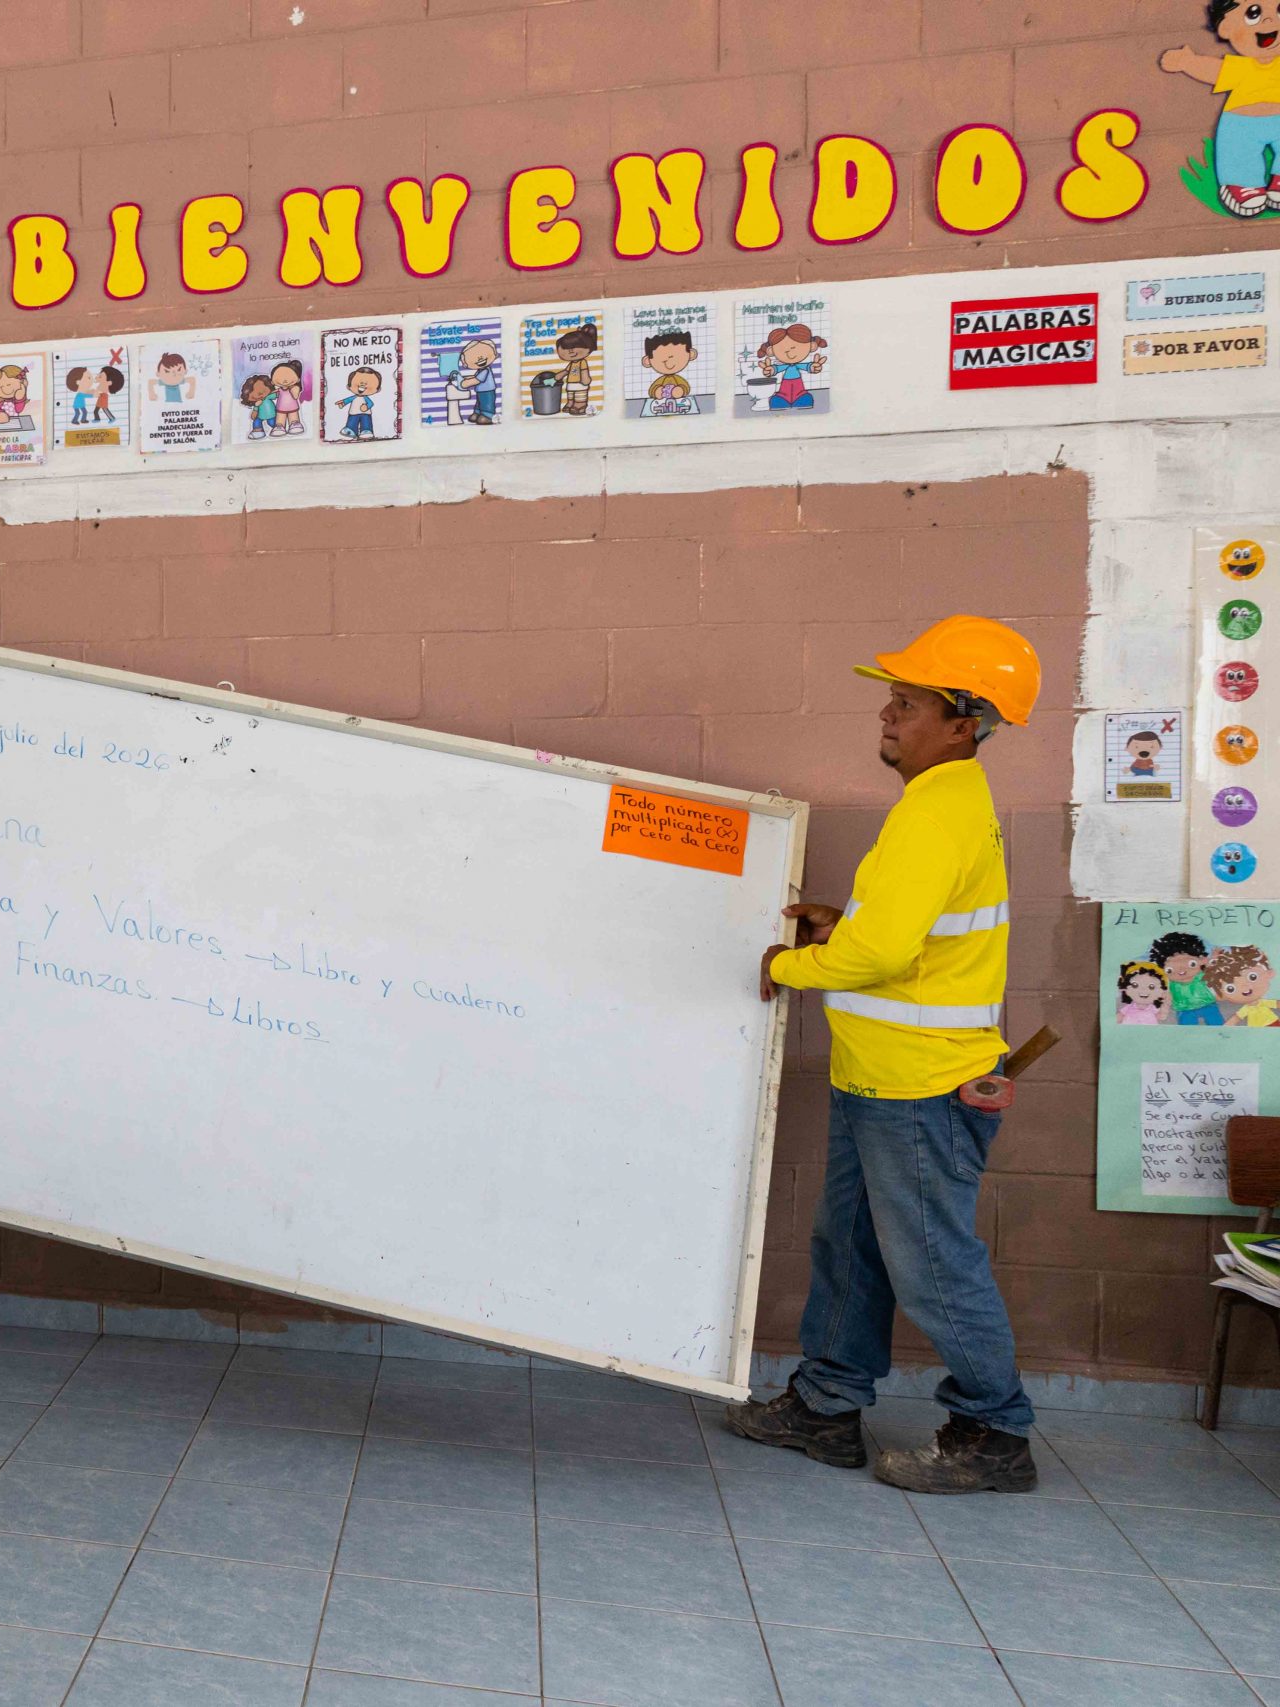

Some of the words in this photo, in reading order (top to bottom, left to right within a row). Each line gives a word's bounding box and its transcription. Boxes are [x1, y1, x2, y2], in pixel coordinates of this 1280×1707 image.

[8, 109, 1148, 310] BIENVENIDOS
[1164, 293, 1223, 307] BUENOS
[1228, 288, 1262, 303] DÍAS
[633, 309, 656, 318] Lava
[658, 307, 673, 317] tus
[675, 306, 705, 315] manos
[784, 302, 794, 312] el
[797, 300, 824, 311] baño
[524, 319, 543, 328] Tira
[546, 317, 554, 327] el
[557, 315, 581, 328] papel
[674, 315, 685, 324] de
[687, 315, 695, 323] ir
[697, 313, 707, 322] al
[768, 314, 797, 326] limpio
[955, 308, 1092, 334] PALABRAS
[428, 324, 463, 337] Lávate
[467, 323, 481, 334] las
[524, 329, 533, 338] el
[536, 328, 556, 337] bote
[240, 341, 268, 351] Ayudo
[279, 338, 300, 348] quien
[334, 337, 350, 348] NO
[353, 336, 368, 347] ME
[371, 335, 391, 346] RIO
[429, 336, 462, 346] manos
[524, 338, 536, 347] de
[1152, 342, 1191, 357] POR
[1193, 337, 1260, 354] FAVOR
[249, 354, 257, 362] lo
[524, 347, 554, 356] basura
[331, 357, 341, 367] DE
[343, 355, 360, 366] LOS
[363, 351, 392, 365] DEMÁS
[525, 408, 532, 417] 2
[425, 415, 432, 425] 4
[157, 423, 204, 431] INADECUADAS
[1, 454, 32, 462] PARTICIPAR
[54, 732, 84, 759] del
[102, 743, 170, 770] 2026
[615, 793, 656, 811] Todo
[665, 805, 733, 827] número
[614, 808, 711, 835] multiplicado
[611, 822, 632, 836] por
[681, 833, 699, 847] da
[1157, 905, 1274, 927] RESPETO
[302, 943, 361, 986] Libro
[232, 997, 321, 1038] Libros
[1154, 1071, 1171, 1083] El
[1182, 1071, 1243, 1087] Valor
[1145, 1085, 1169, 1099] del
[1179, 1089, 1235, 1101] respeto
[1145, 1111, 1160, 1120] Se
[1165, 1110, 1202, 1124] ejerce
[1175, 1155, 1188, 1164] el
[1193, 1167, 1206, 1179] de
